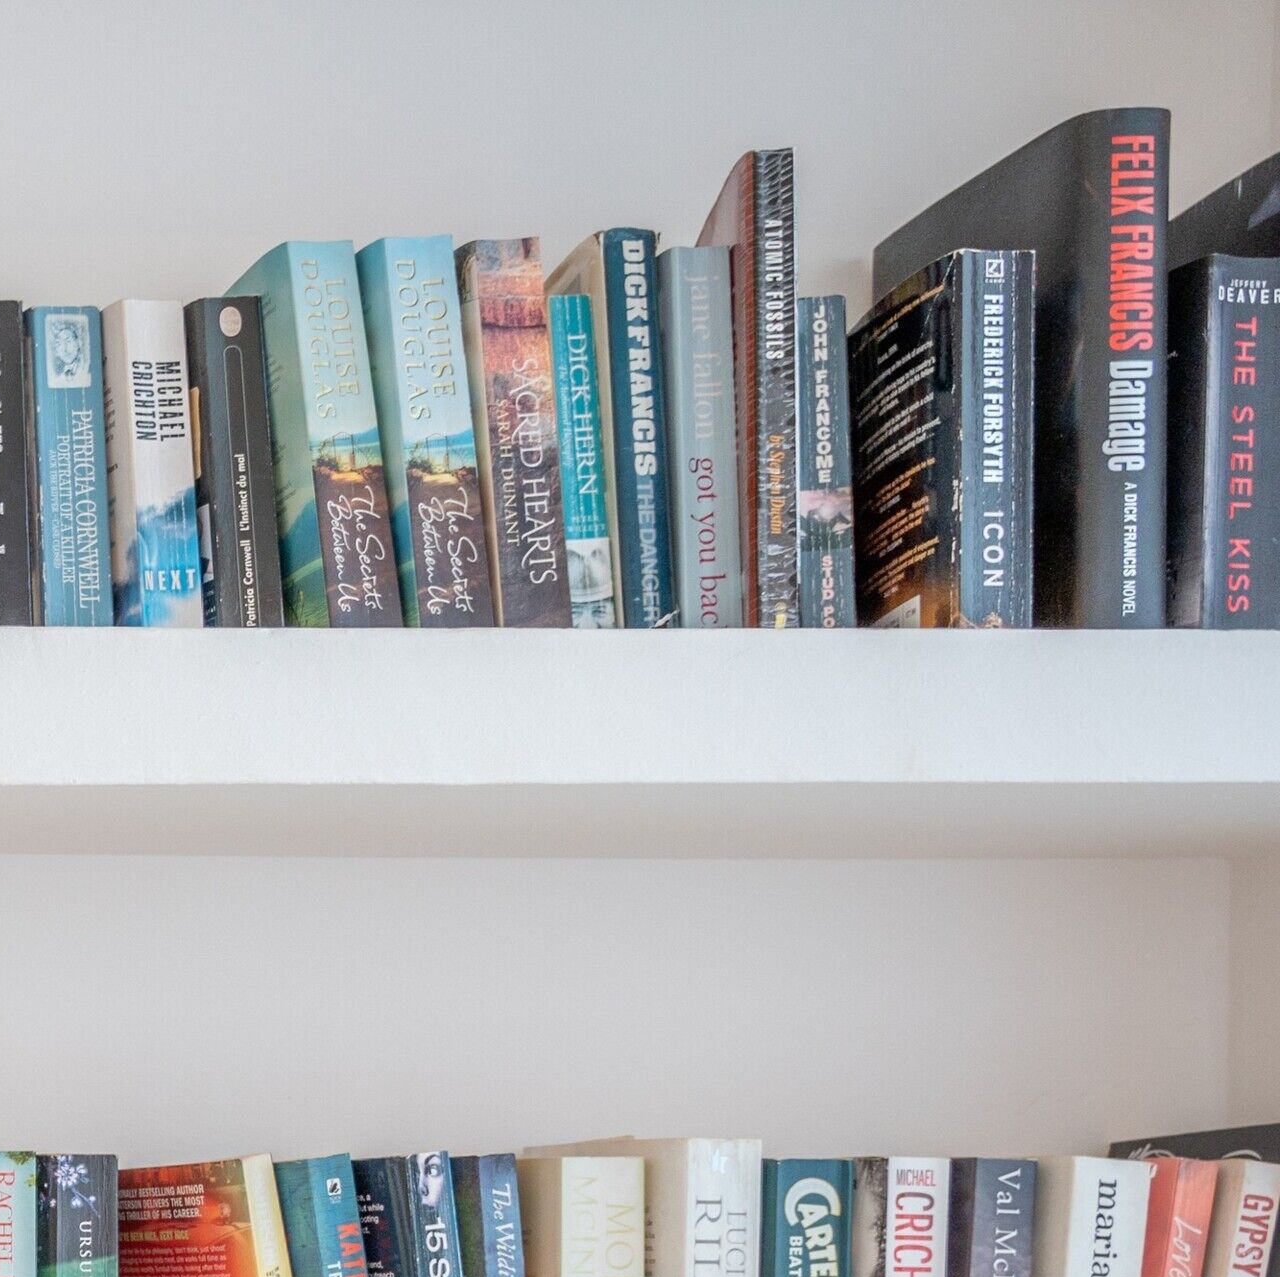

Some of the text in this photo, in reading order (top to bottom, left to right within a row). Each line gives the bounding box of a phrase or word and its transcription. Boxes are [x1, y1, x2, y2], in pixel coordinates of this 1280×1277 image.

[622, 240, 656, 475] DICK FRANCIS
[765, 219, 784, 360] ATOMIC FOSSILS
[1101, 135, 1154, 471] FELIX FRANCIS Damage
[511, 358, 557, 584] SACRED HEARTS
[983, 294, 1004, 587] FREDERICK FORSYTH ICON
[1228, 317, 1257, 613] THE STEEL KISS
[424, 1218, 447, 1252] 15
[1233, 1193, 1274, 1277] GYPSY
